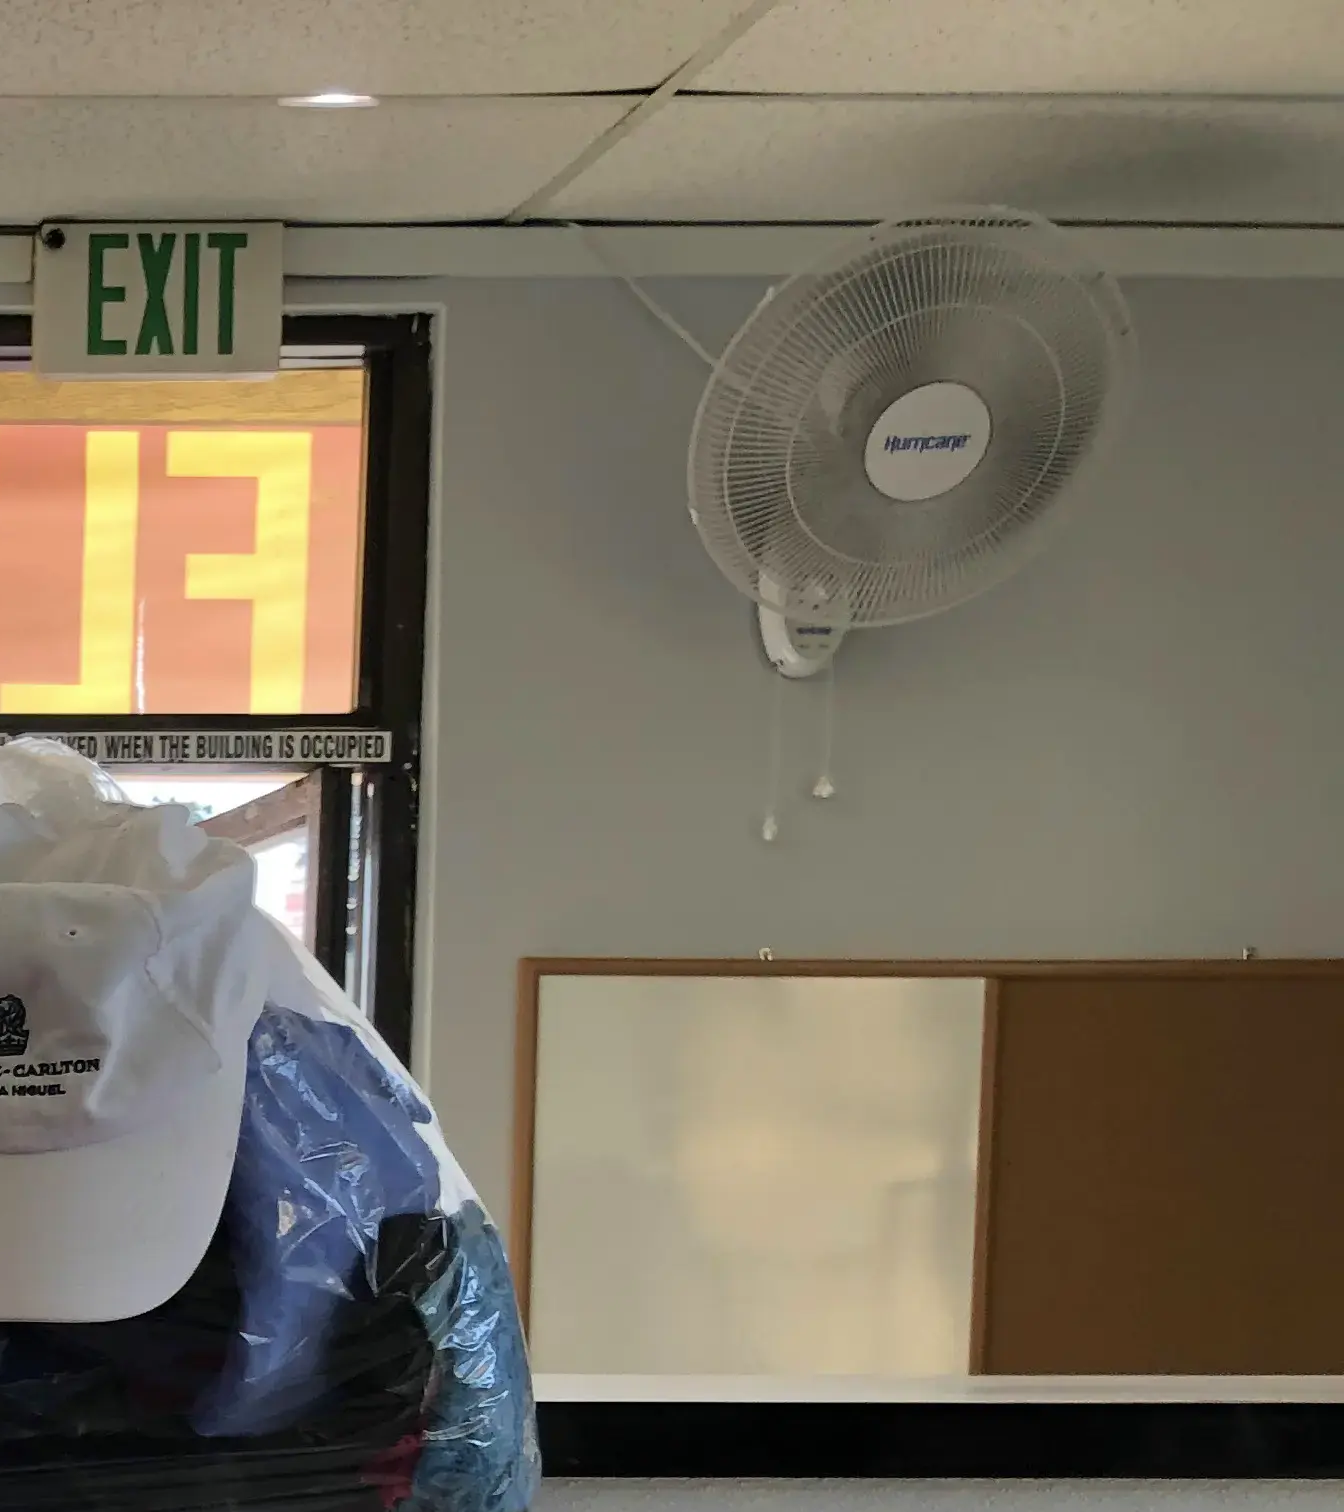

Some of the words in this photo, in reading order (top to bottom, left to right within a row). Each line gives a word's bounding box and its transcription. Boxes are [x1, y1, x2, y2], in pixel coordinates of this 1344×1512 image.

[87, 233, 248, 355] EXIT
[105, 735, 153, 759] WHEN
[159, 735, 190, 758] THE
[196, 735, 273, 758] BUILDING
[279, 735, 295, 758] IS
[300, 734, 385, 758] OCCUPIED
